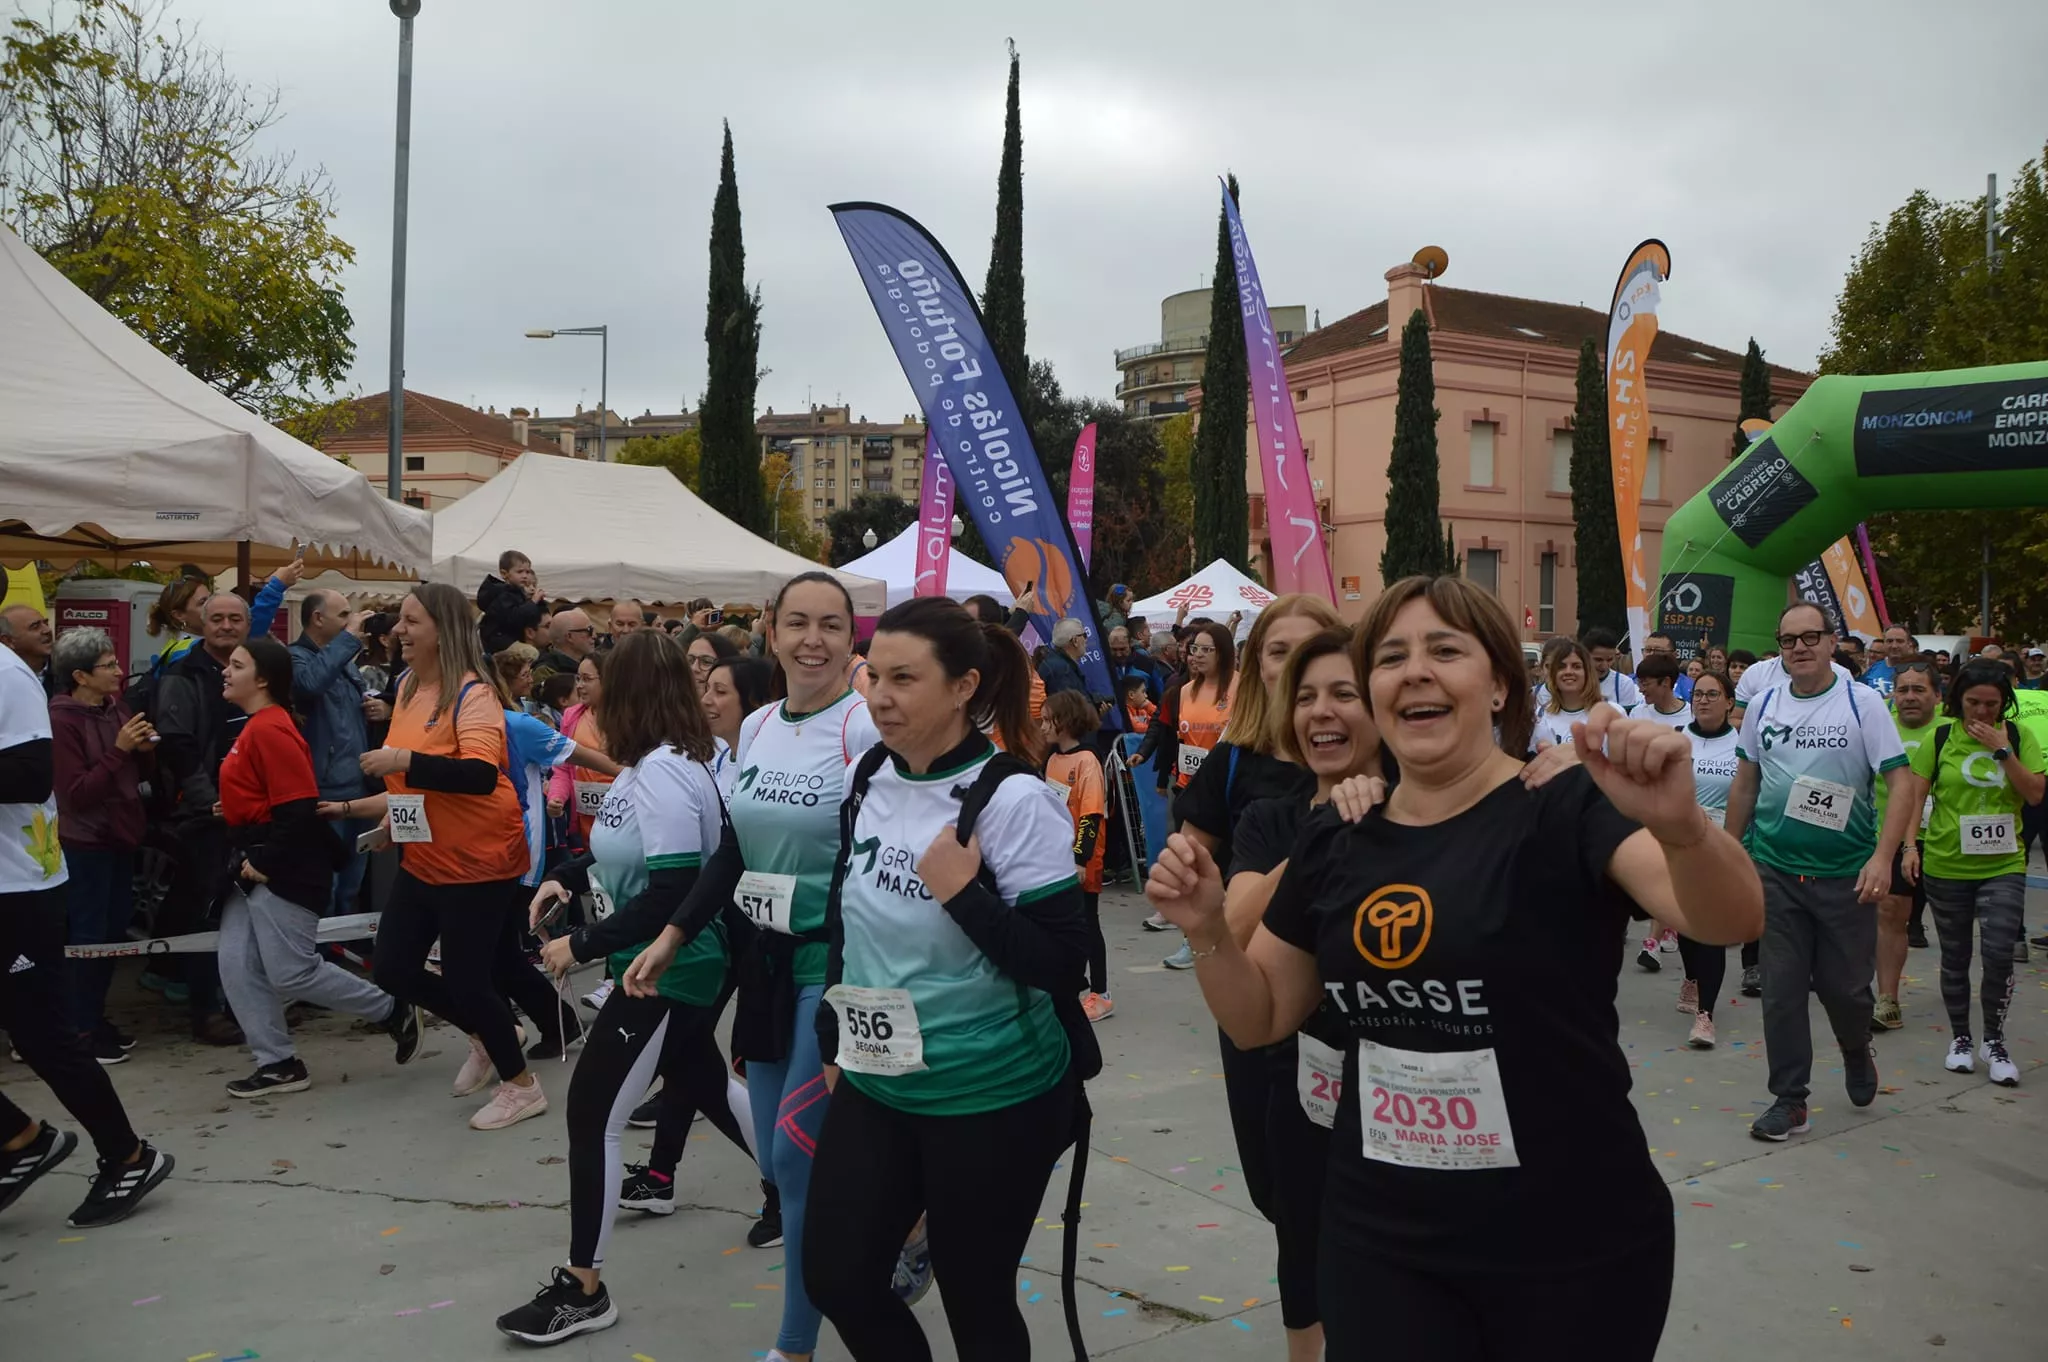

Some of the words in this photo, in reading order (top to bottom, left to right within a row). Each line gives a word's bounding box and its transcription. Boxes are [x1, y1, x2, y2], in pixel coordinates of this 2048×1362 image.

[1994, 410, 2048, 429] EMPR
[1988, 429, 2048, 448] MONZ
[1716, 460, 1769, 507] Automóviles
[1727, 458, 1787, 511] CABRERO
[924, 447, 949, 561] alum
[1663, 613, 1715, 627] ESPIAS
[1795, 725, 1848, 737] GRUPO
[1795, 738, 1848, 749] MARCO
[761, 771, 824, 790] GRUPO
[753, 787, 819, 807] MARCO
[1807, 790, 1834, 810] 54
[392, 808, 417, 824] 504
[1798, 804, 1822, 815] ANGEL
[1823, 811, 1838, 819] LUIS
[1971, 825, 2006, 839] 610
[876, 869, 934, 901] MARC
[742, 895, 773, 922] 571
[1324, 979, 1489, 1016] TAGSE
[846, 1006, 893, 1041] 556
[855, 1040, 891, 1055] BEGOÑA
[1372, 1086, 1478, 1131] 2030
[1369, 1127, 1388, 1142] EF19
[1395, 1128, 1449, 1147] MARIA
[1453, 1132, 1502, 1147] JOSE
